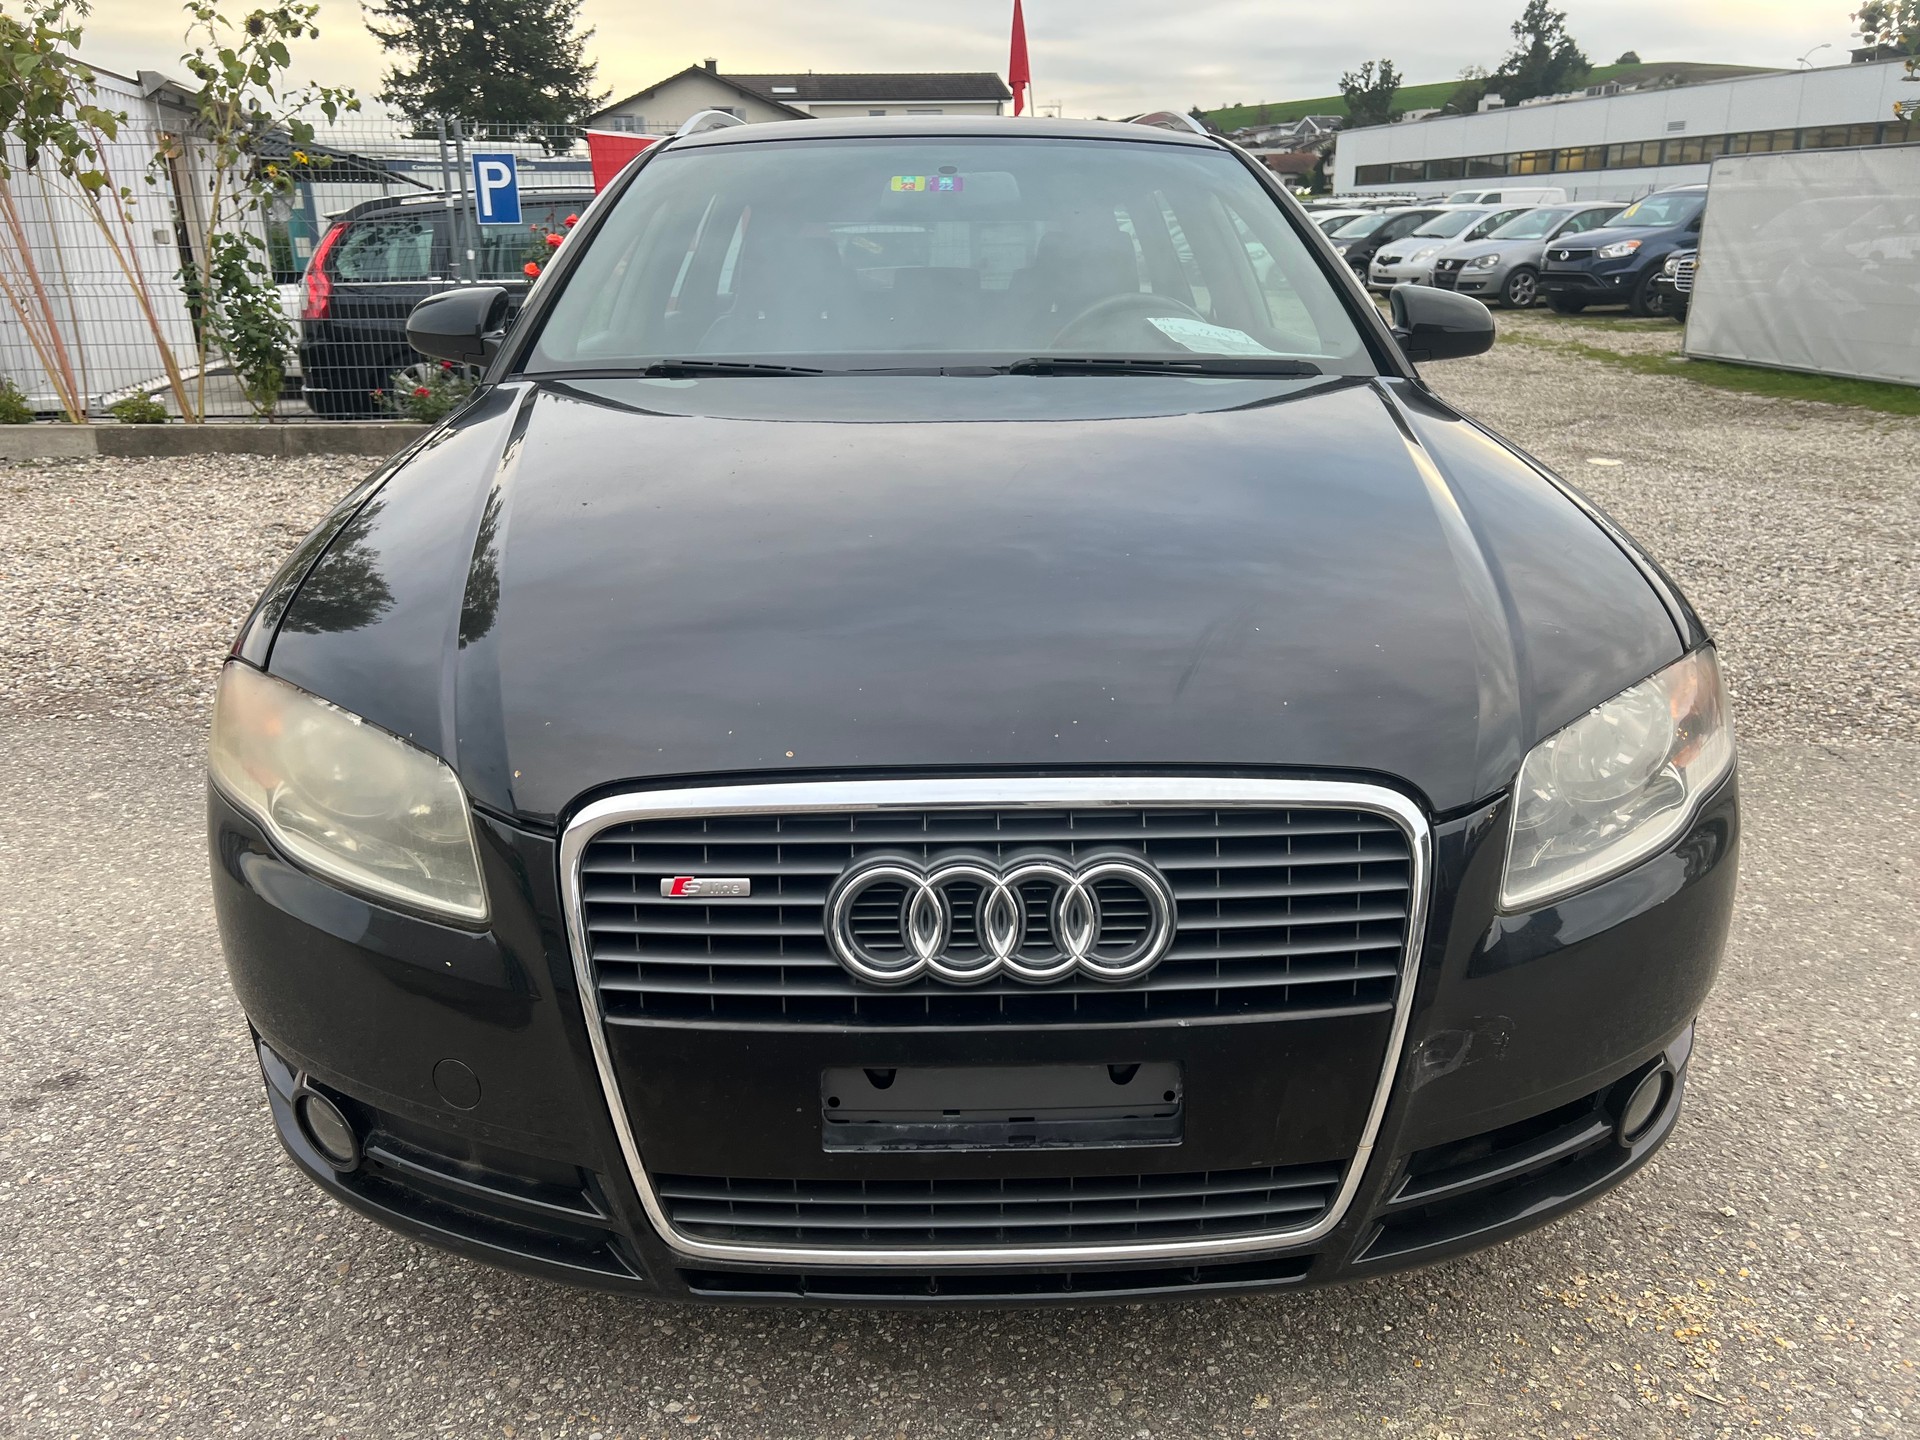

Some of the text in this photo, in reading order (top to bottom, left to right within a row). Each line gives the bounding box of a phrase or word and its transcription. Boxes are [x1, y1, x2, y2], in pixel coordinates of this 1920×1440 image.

[478, 161, 511, 216] P
[939, 183, 954, 191] 22
[677, 878, 741, 895] S line
